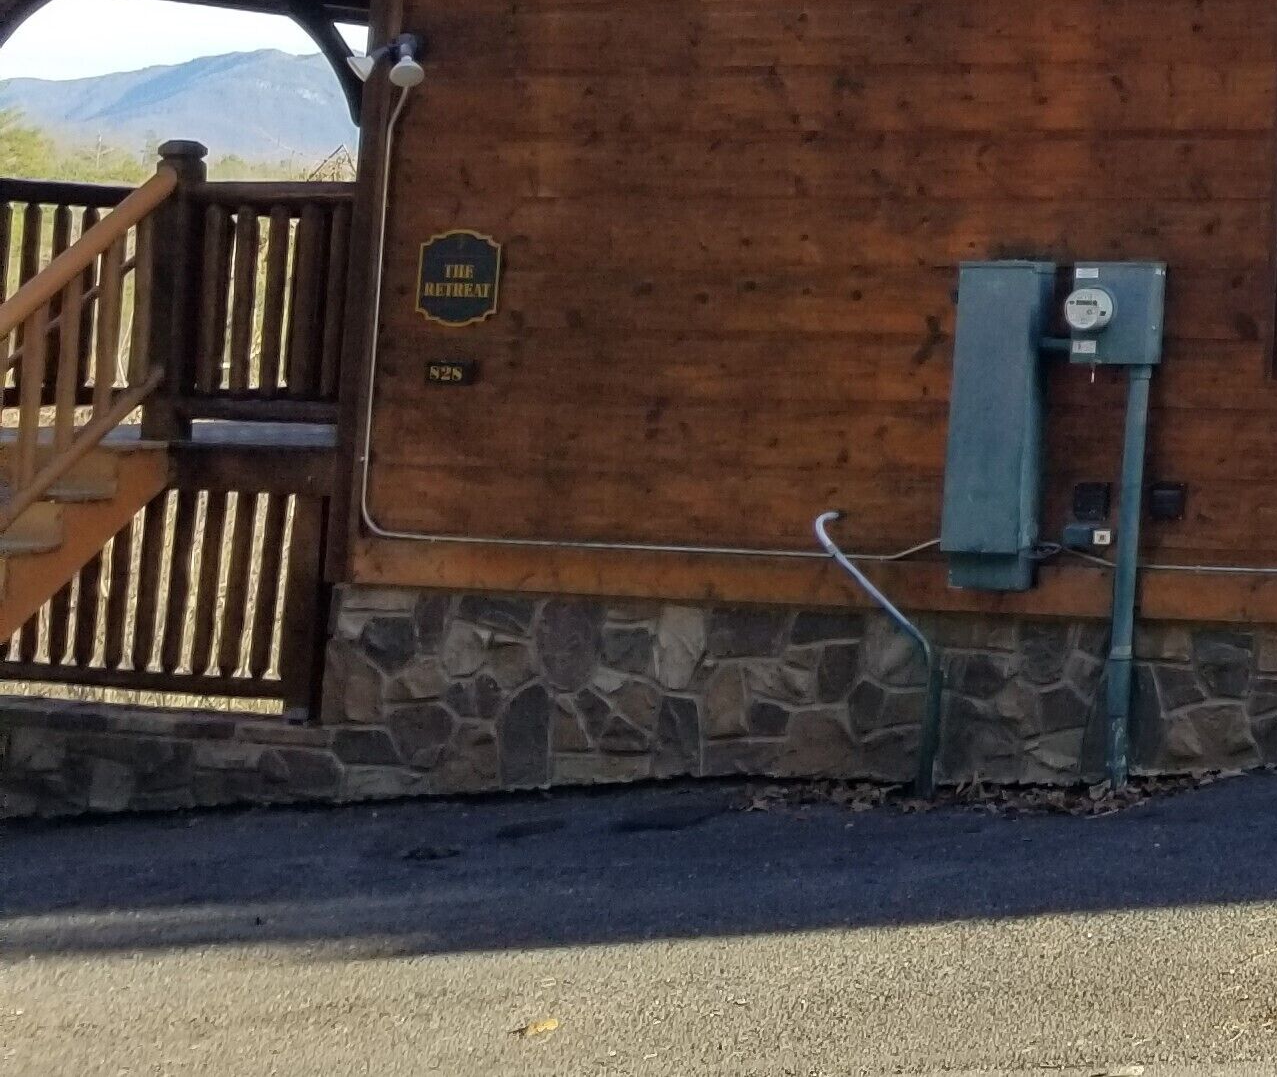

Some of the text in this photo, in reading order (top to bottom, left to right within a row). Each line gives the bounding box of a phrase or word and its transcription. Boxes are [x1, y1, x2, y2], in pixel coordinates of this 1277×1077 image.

[445, 264, 474, 278] THE
[424, 283, 491, 298] RETREAT
[430, 366, 463, 381] 828
